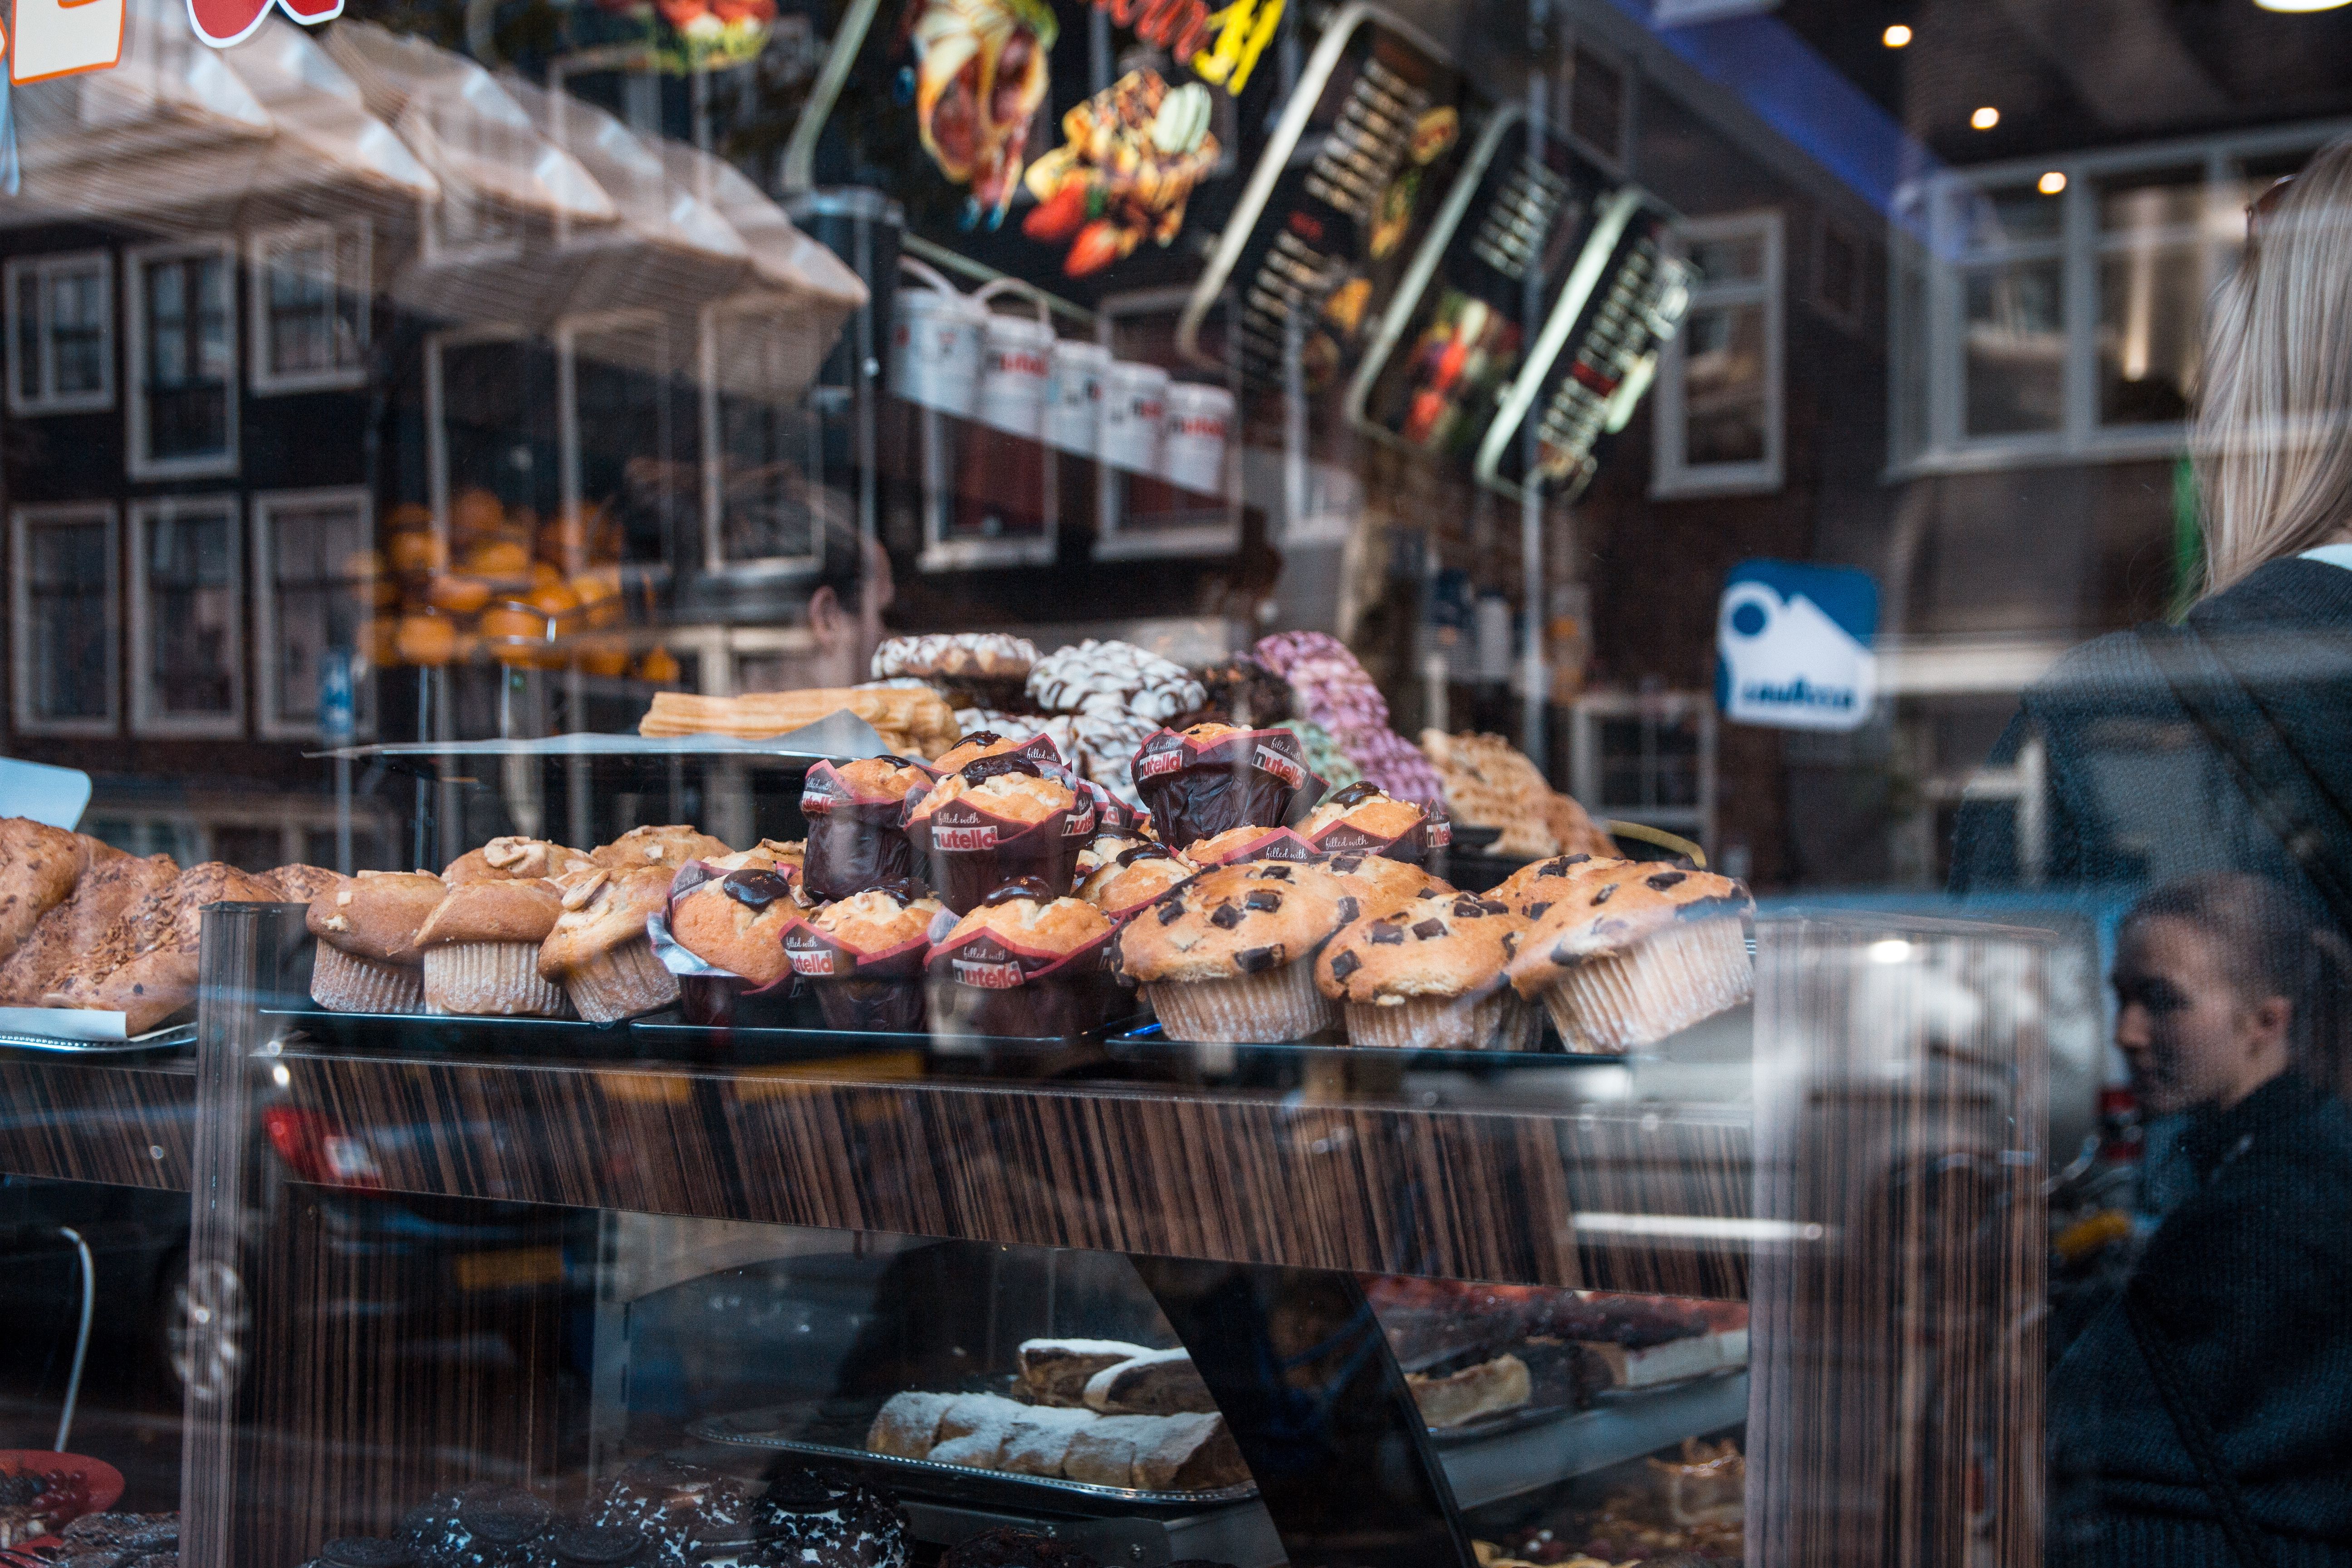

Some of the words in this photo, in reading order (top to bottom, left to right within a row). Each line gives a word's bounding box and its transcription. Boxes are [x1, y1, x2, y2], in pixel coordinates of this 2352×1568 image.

[1271, 737, 1290, 754] filled
[1027, 747, 1046, 760] filled
[1047, 752, 1058, 762] with
[1139, 753, 1181, 778] nutella
[1253, 751, 1304, 790] nutella
[938, 812, 959, 825] filled
[960, 812, 980, 824] with
[1325, 837, 1348, 850] filled
[1348, 834, 1369, 847] with
[1265, 847, 1289, 859] filled
[1290, 848, 1308, 860] with
[786, 936, 802, 949] filled
[803, 936, 818, 948] with
[963, 946, 987, 960] filled
[791, 953, 833, 973] utella
[954, 966, 1023, 988] nutella
